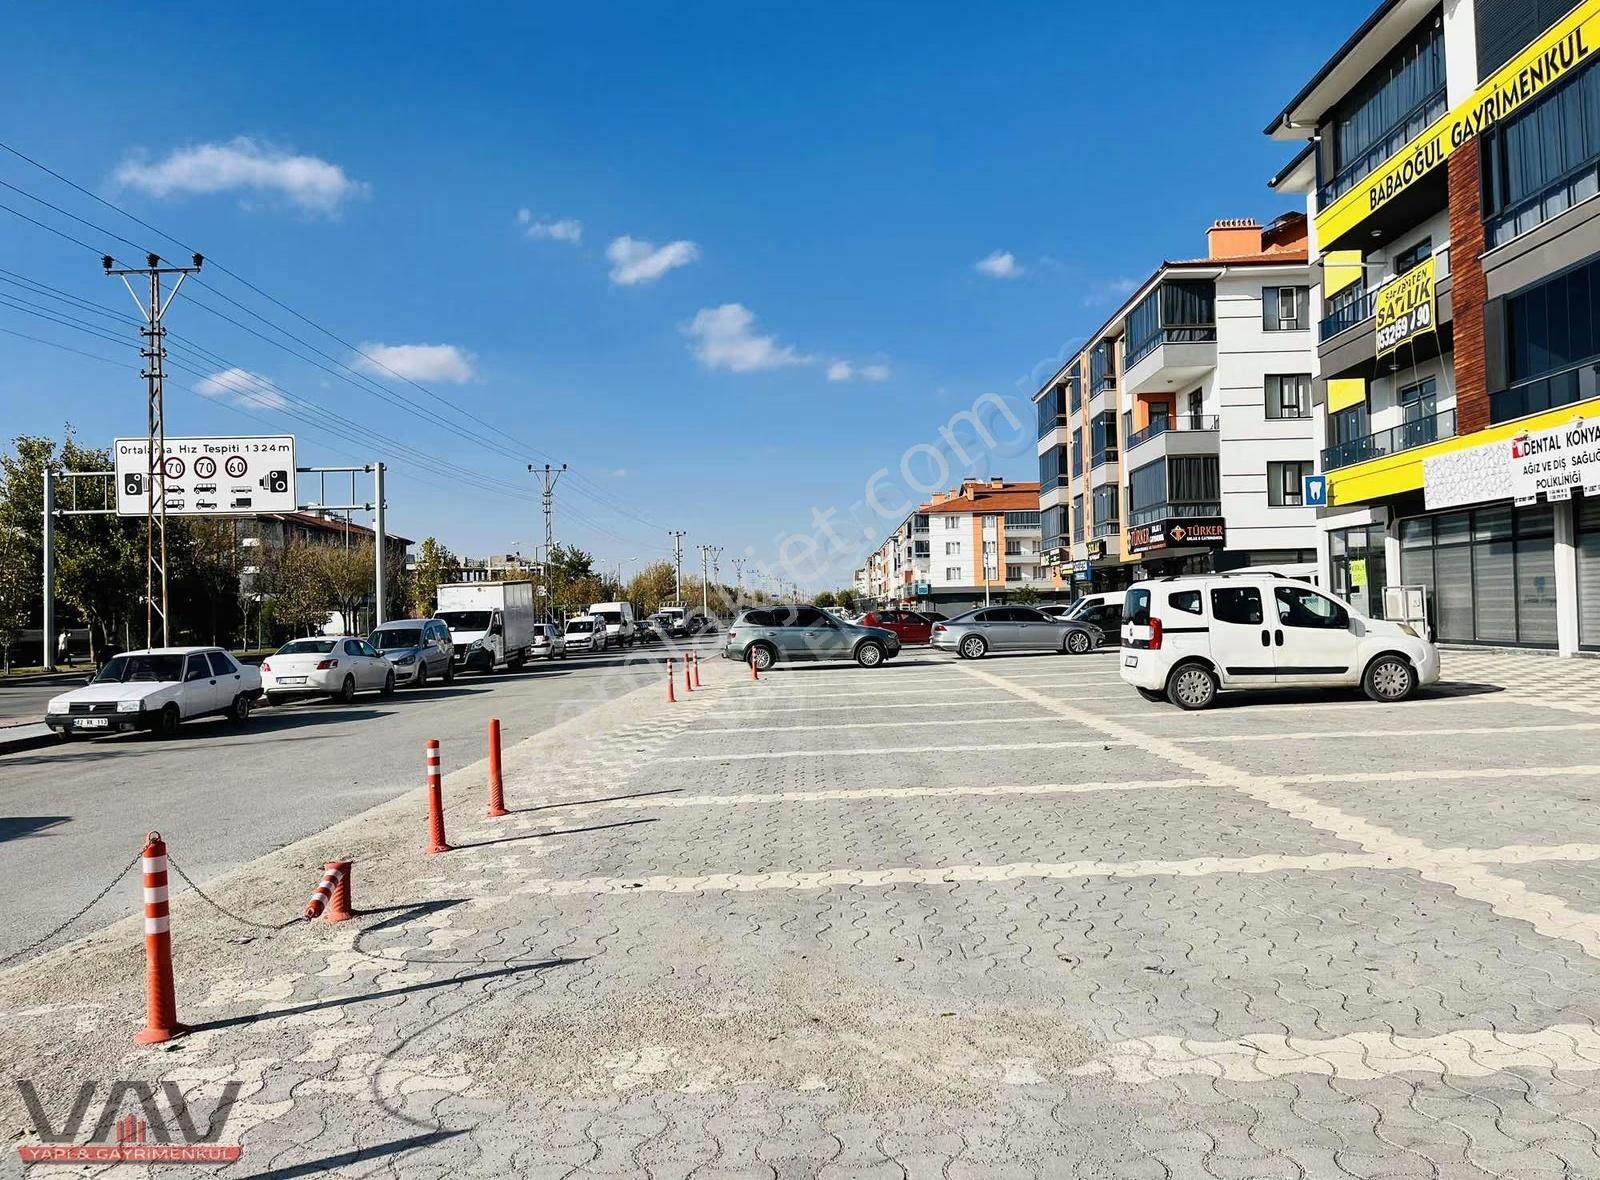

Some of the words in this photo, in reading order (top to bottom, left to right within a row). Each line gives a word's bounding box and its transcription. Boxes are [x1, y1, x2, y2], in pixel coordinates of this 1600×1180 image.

[1369, 144, 1445, 211] BABAOĞUL
[1451, 25, 1589, 149] GAYRİMENKUL
[1523, 434, 1562, 456] DENTAL
[1566, 425, 1600, 447] KONYA
[203, 444, 240, 455] Tespiti
[168, 463, 182, 474] 70
[199, 462, 213, 473] 70
[229, 462, 244, 473] 60
[1523, 461, 1541, 476] AĞIZ
[1541, 461, 1552, 472] VE
[1553, 456, 1567, 471] DİŞ
[1536, 470, 1582, 490] POLİKLİNİĞİ
[1187, 524, 1224, 537] TÜRKER
